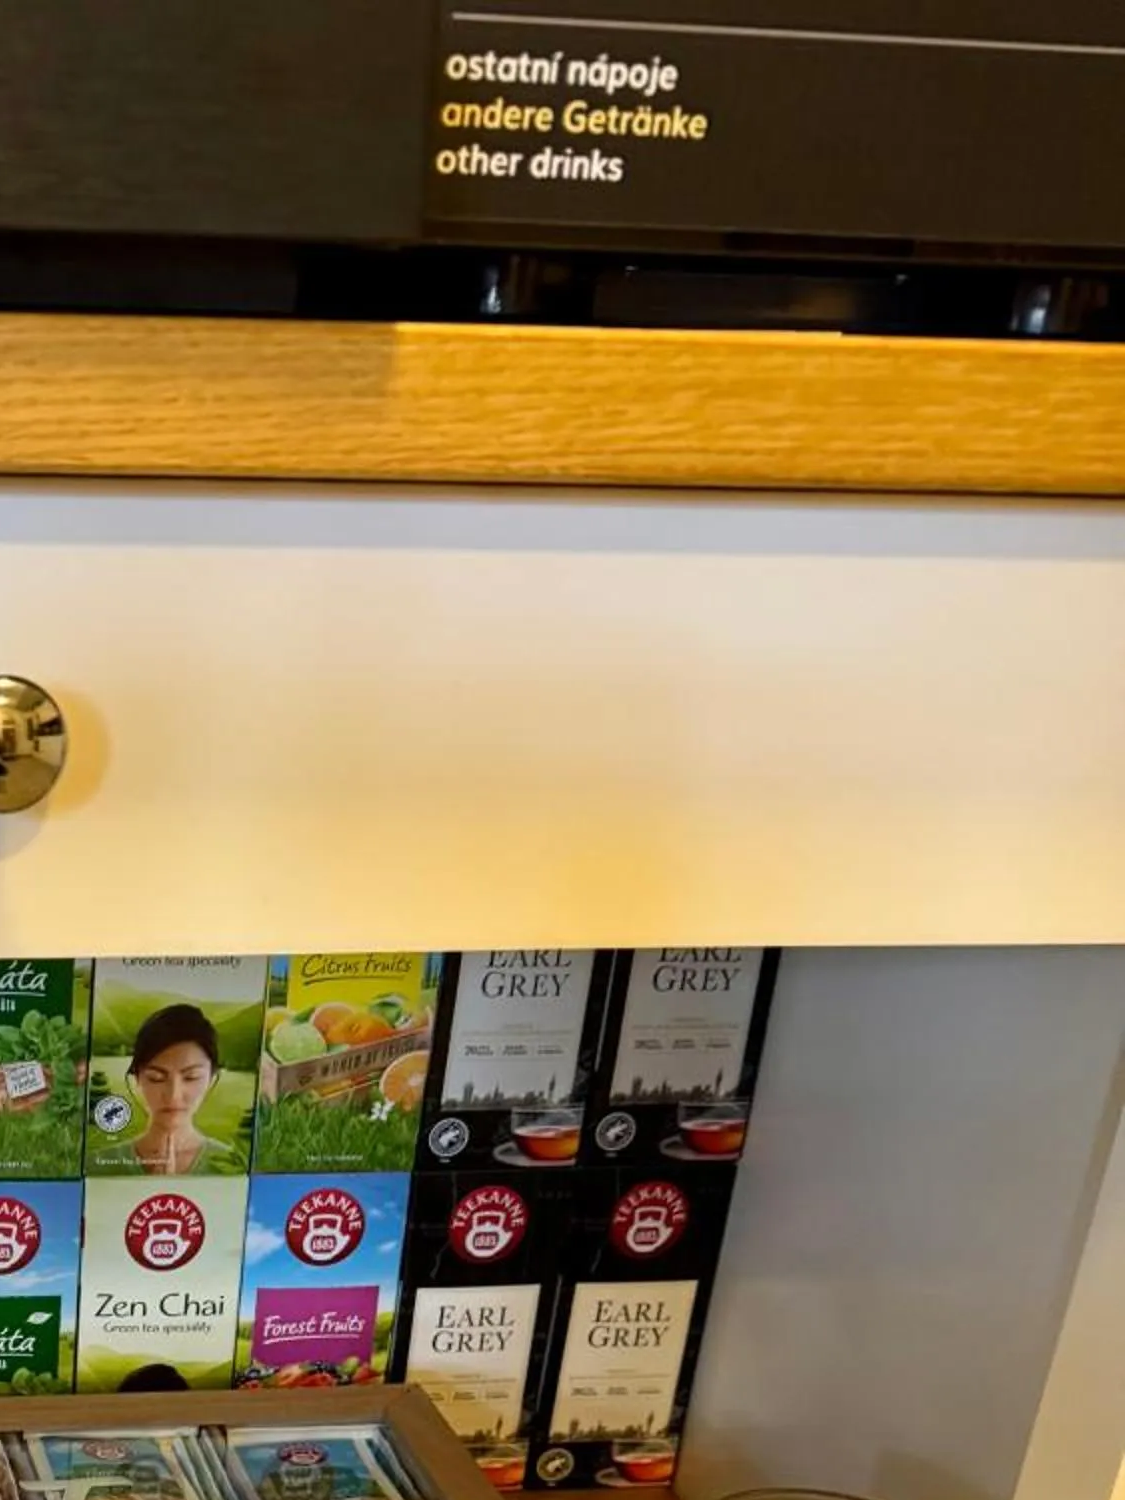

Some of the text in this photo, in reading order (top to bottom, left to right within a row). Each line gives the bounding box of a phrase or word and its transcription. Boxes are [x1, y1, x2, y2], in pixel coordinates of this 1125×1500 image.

[445, 51, 678, 96] ostatní nápoje
[441, 97, 708, 139] andere Getränke
[436, 144, 624, 182] other drinks
[301, 953, 412, 977] Citrus Fruits
[486, 949, 573, 968] EARL
[481, 971, 571, 998] GREY
[652, 966, 742, 992] GREY
[128, 1199, 202, 1238] TEEKANNE
[288, 1193, 362, 1232] TEEKANNE
[451, 1190, 525, 1231] TEEKANNE
[613, 1186, 687, 1225] TEEKANNE
[94, 1292, 225, 1318] Zen Chai
[436, 1304, 515, 1329] EARL
[592, 1300, 671, 1323] EARL
[103, 1322, 140, 1333] Green
[142, 1323, 160, 1333] tea
[263, 1312, 365, 1337] Forest Fruits
[587, 1326, 670, 1348] GREY
[431, 1330, 514, 1353] GREY
